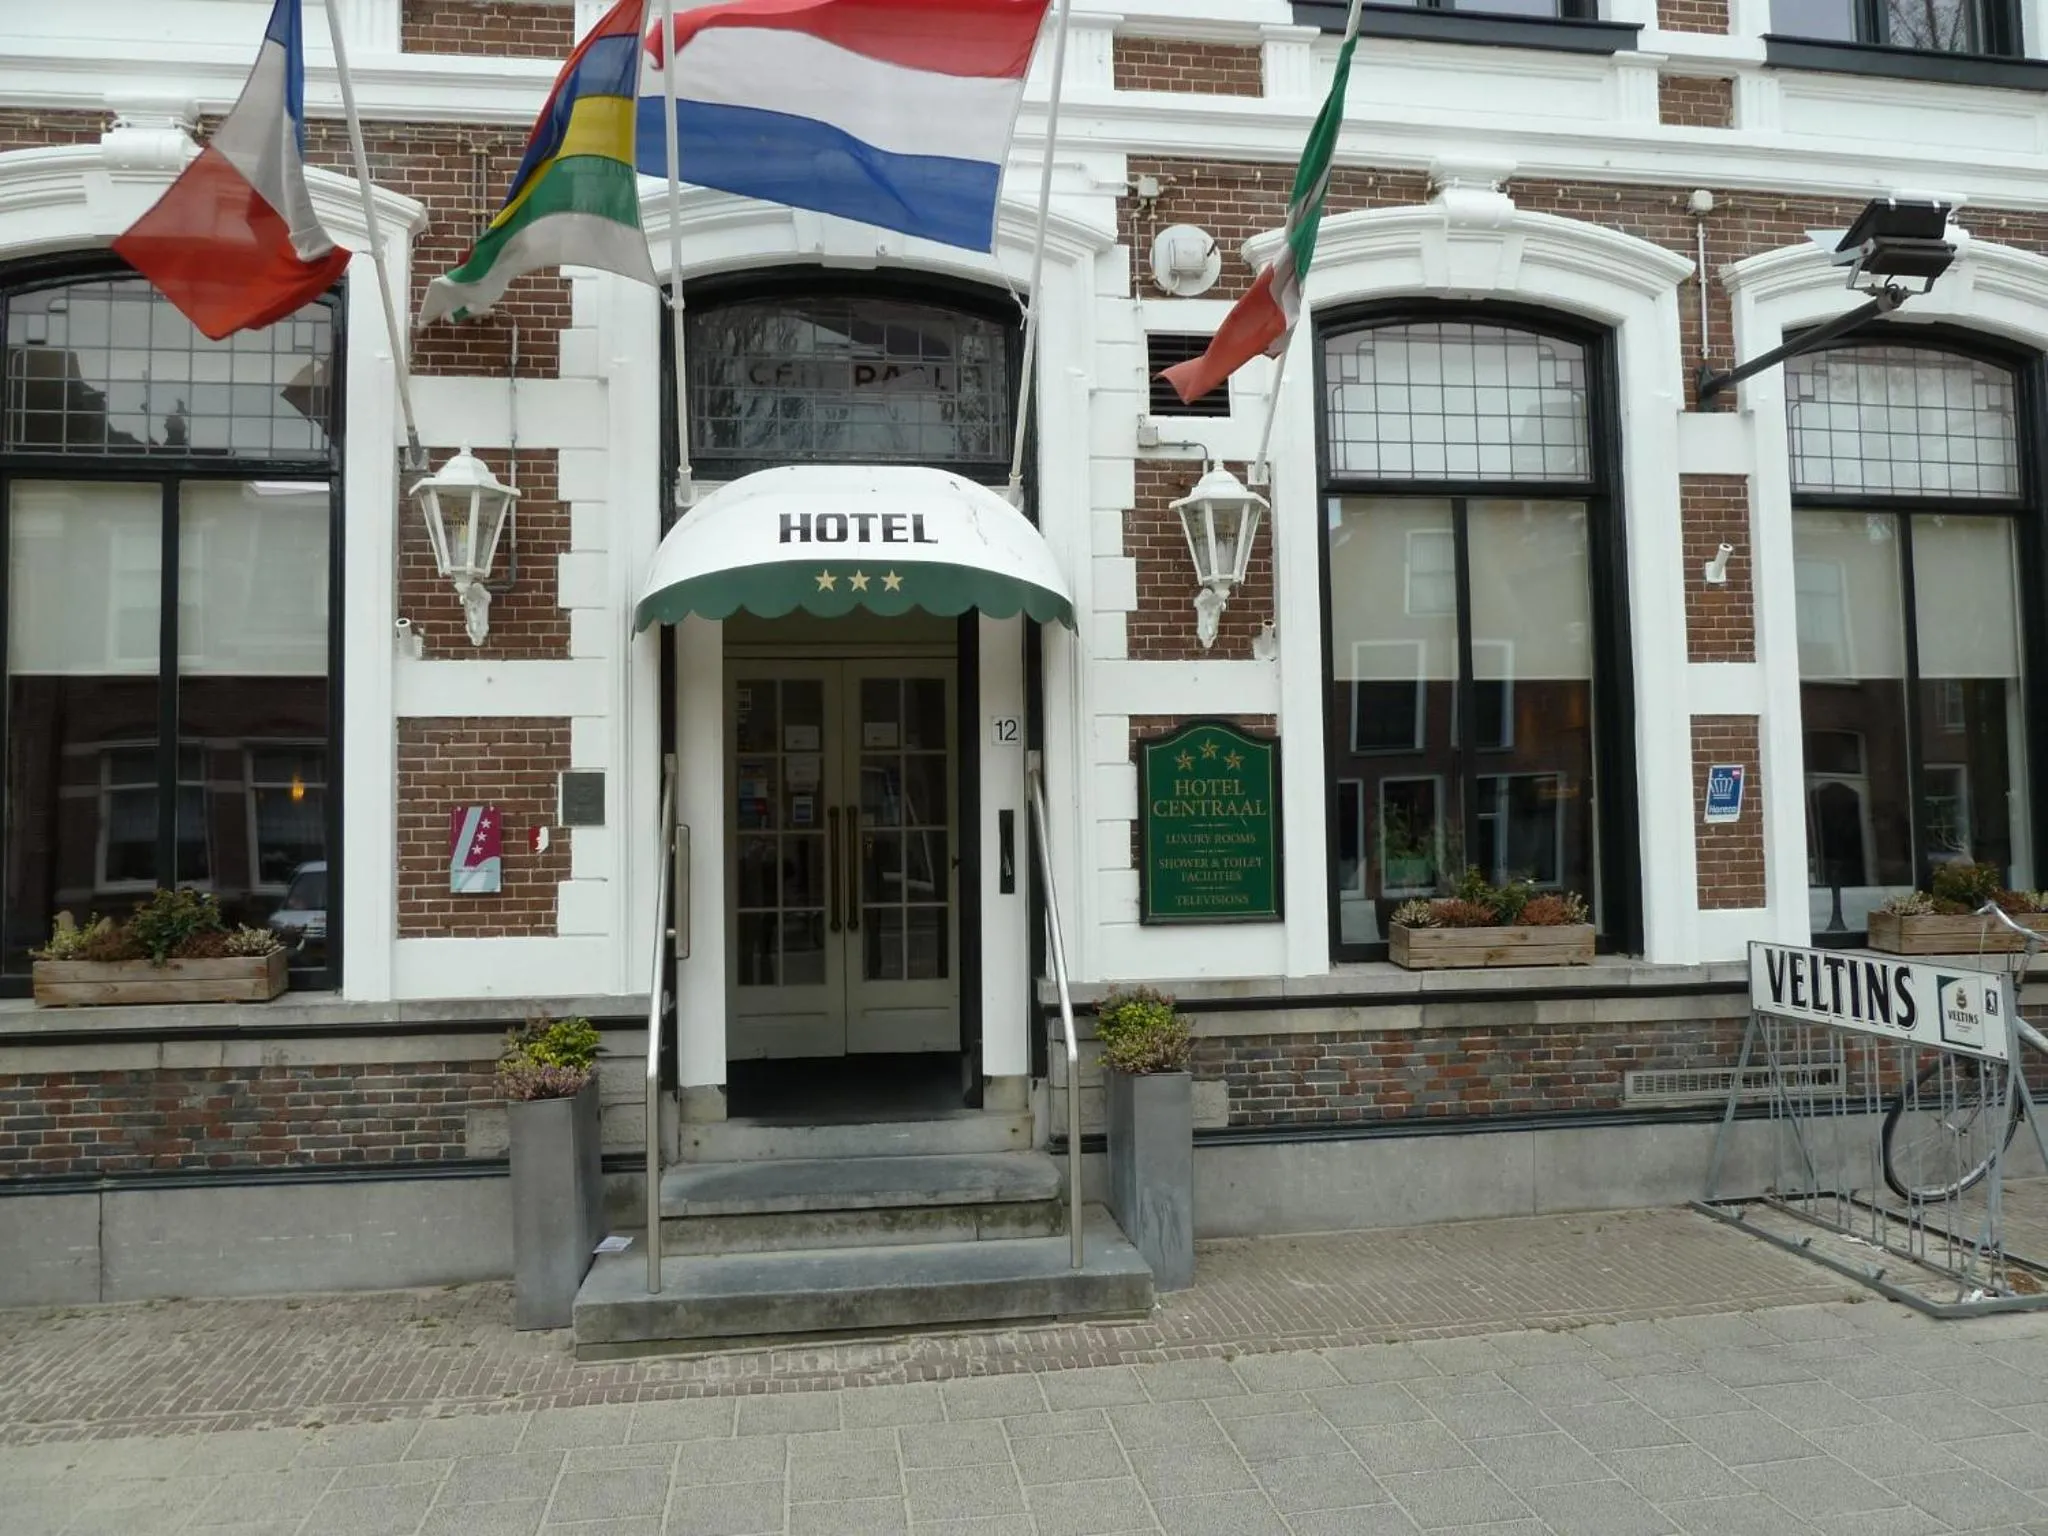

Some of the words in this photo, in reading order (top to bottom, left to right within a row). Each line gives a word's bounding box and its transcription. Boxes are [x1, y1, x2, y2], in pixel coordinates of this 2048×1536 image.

[778, 512, 939, 545] HOTEL
[995, 720, 1017, 741] 12
[1175, 779, 1245, 797] HOTEL
[1152, 799, 1267, 818] CENTRAAL
[1165, 833, 1211, 845] LUXURY
[1214, 832, 1256, 845] ROOMS
[1158, 857, 1208, 870] SHOWER
[1210, 858, 1220, 868] &
[1223, 856, 1263, 868] TOILET
[1181, 871, 1243, 882] FACILITIES
[1175, 894, 1249, 906] TELEVISIONS
[1765, 948, 1917, 1029] VELTINS
[1947, 1009, 1979, 1025] VELTINS
